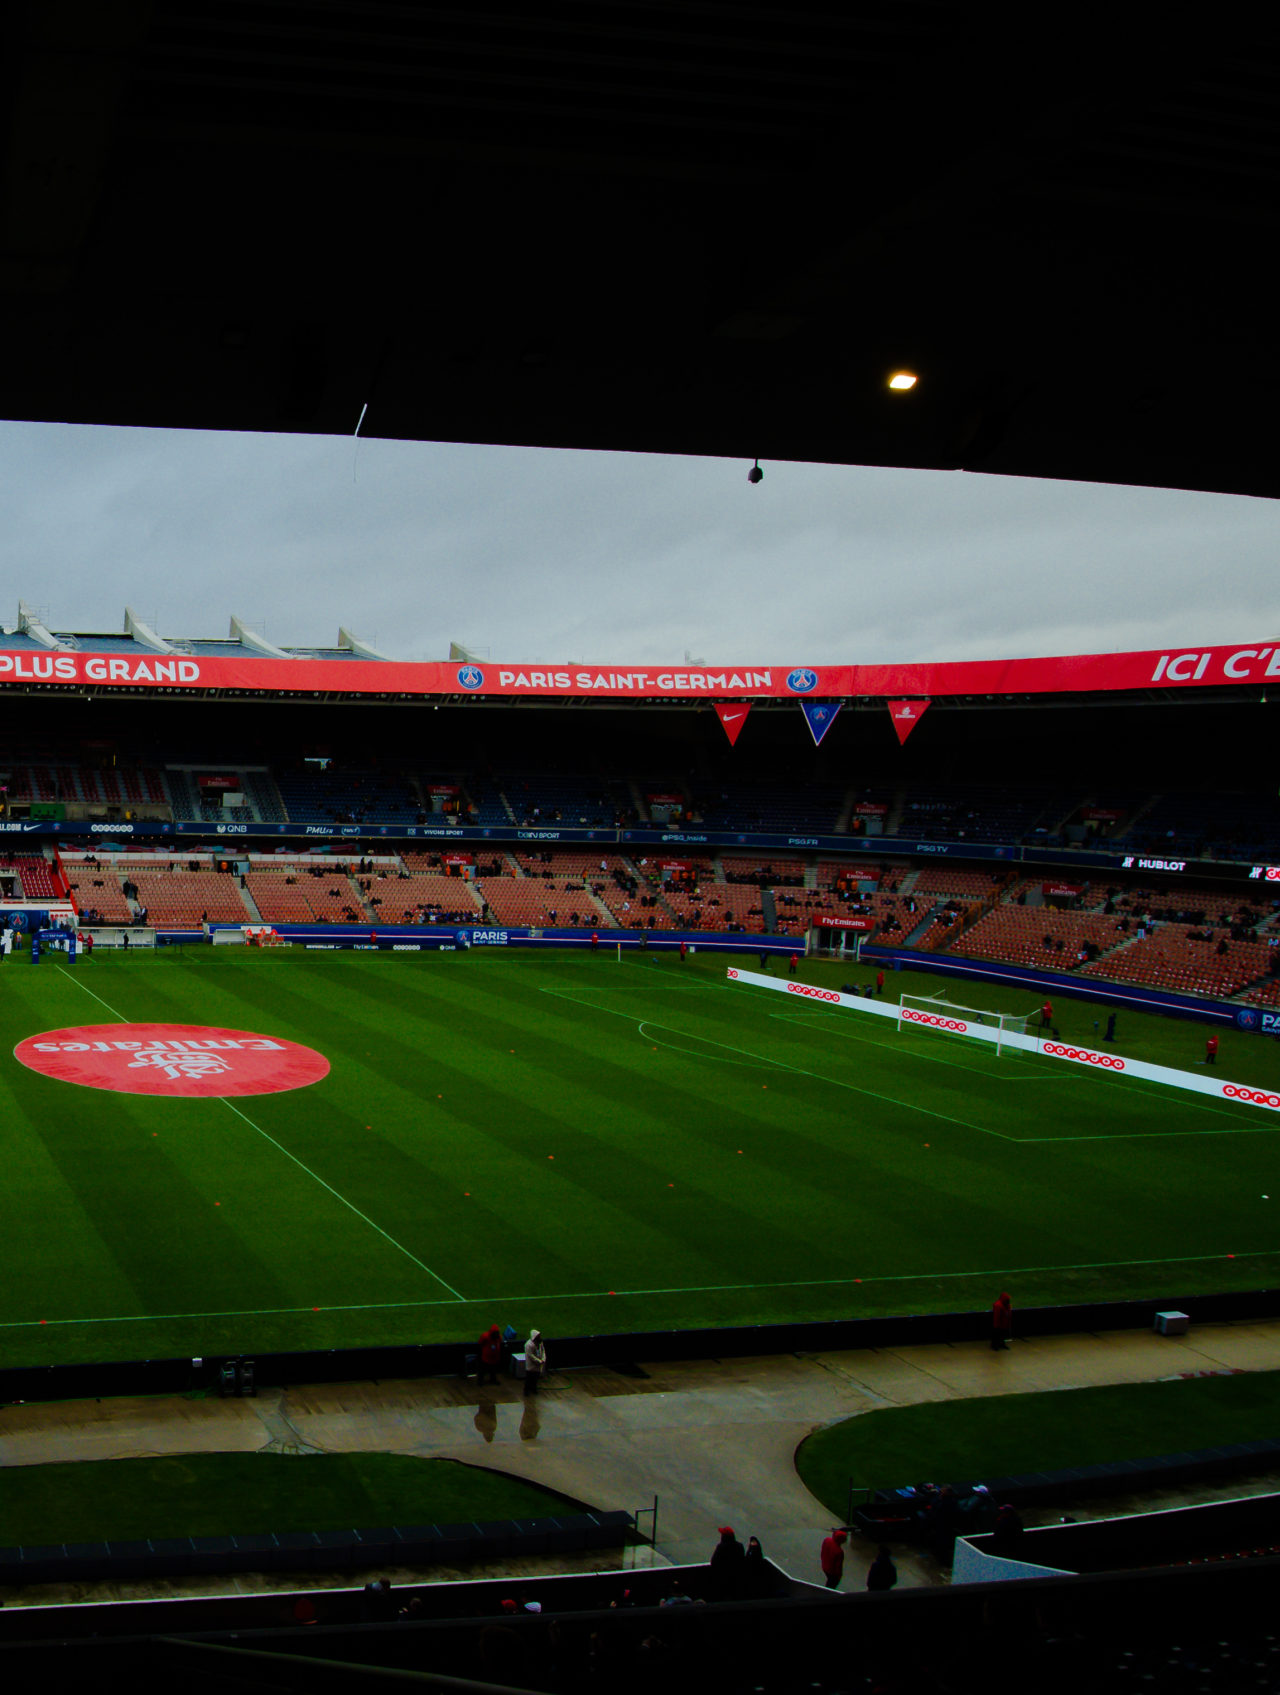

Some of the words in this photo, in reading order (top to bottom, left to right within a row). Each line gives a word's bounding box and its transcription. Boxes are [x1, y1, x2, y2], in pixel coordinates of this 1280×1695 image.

[85, 659, 200, 682] GRAND
[1151, 653, 1212, 682] ICI
[499, 671, 571, 688] PARIS
[576, 672, 772, 690] SAINT-GERMAIN
[227, 824, 248, 833] QNB
[1138, 859, 1187, 871] HUBLOT
[834, 918, 866, 927] Emirates
[473, 931, 508, 941] PARIS
[787, 983, 840, 1002] ooredoo
[902, 1009, 967, 1032] ooredoo
[32, 1038, 287, 1052] Emirates
[1043, 1043, 1125, 1070] ooredoo
